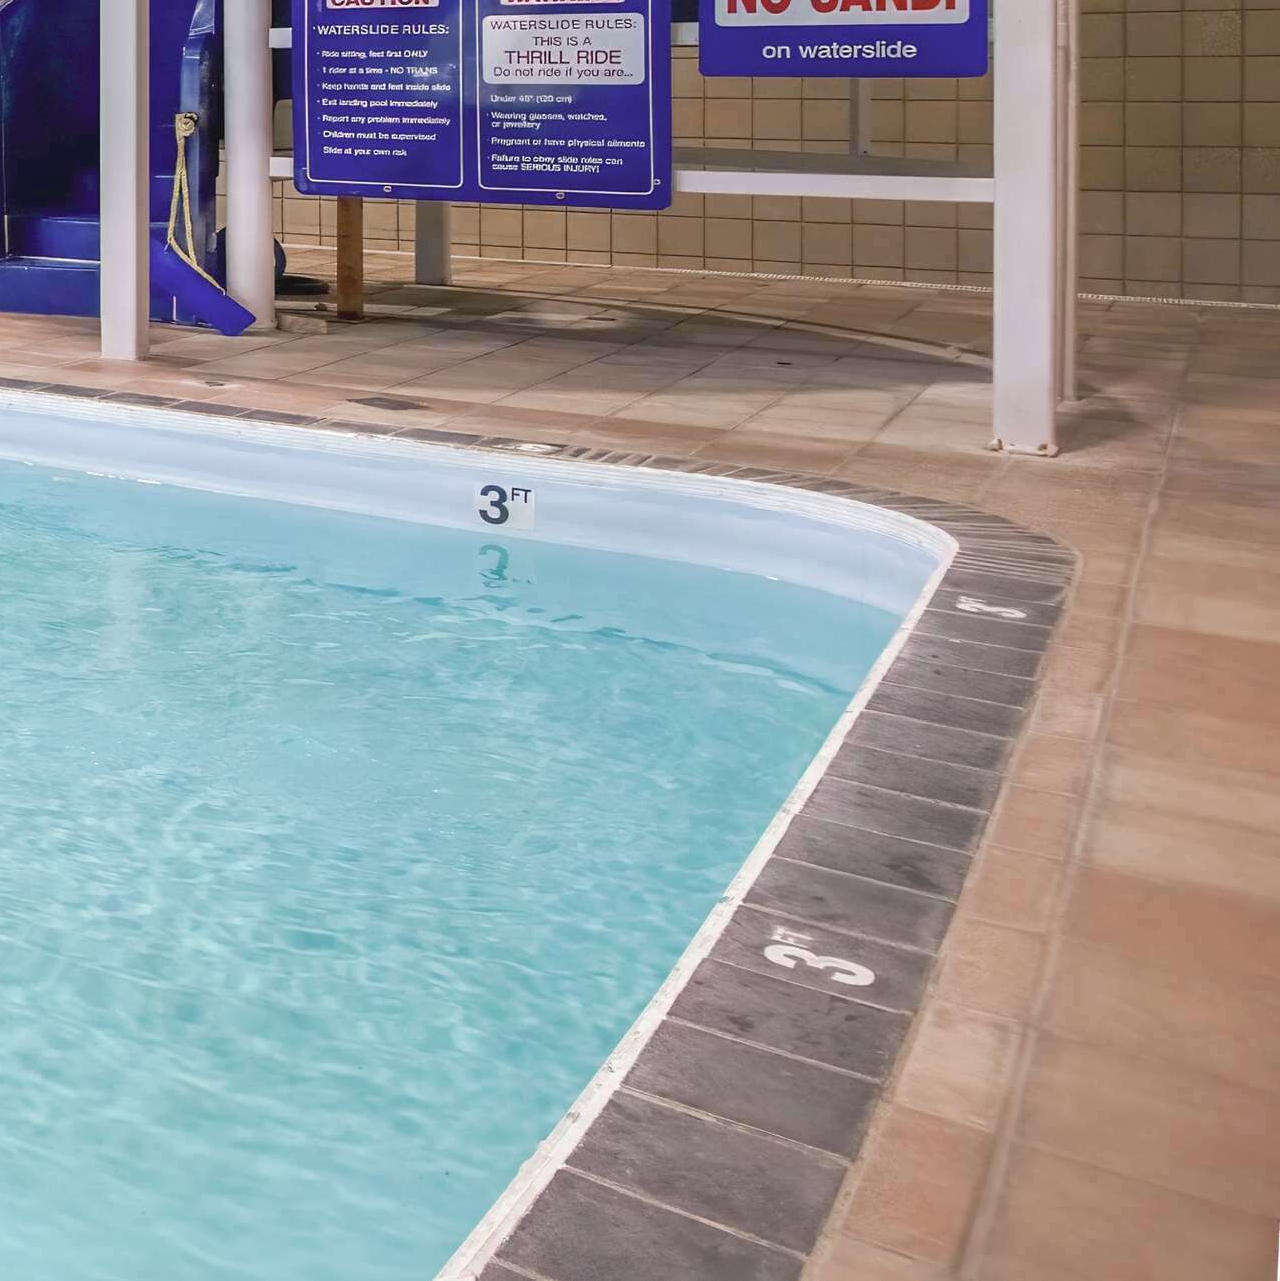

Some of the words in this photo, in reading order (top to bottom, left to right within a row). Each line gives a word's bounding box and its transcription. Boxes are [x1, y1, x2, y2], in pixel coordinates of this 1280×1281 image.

[490, 20, 580, 30] WATERSLIDE
[585, 19, 637, 29] RULES:
[318, 25, 399, 35] WATERSLIDE
[402, 24, 449, 35] RULES:
[532, 36, 562, 47] THIS
[567, 36, 579, 46] IS
[582, 36, 592, 46] A
[762, 44, 791, 59] on
[799, 40, 918, 59] waterslide
[505, 50, 570, 65] THRILL
[577, 50, 622, 65] RIDE
[390, 66, 405, 74] NO
[493, 67, 510, 77] Do
[515, 67, 534, 77] not
[538, 67, 561, 77] ride
[565, 67, 573, 77] if
[577, 69, 599, 80] you
[322, 83, 342, 91] Keep
[490, 95, 516, 103] Under
[370, 100, 388, 108] pool
[322, 115, 349, 123] Report
[491, 111, 527, 121] Wearing
[491, 153, 520, 162] Failure
[521, 163, 561, 172] SERIOUS
